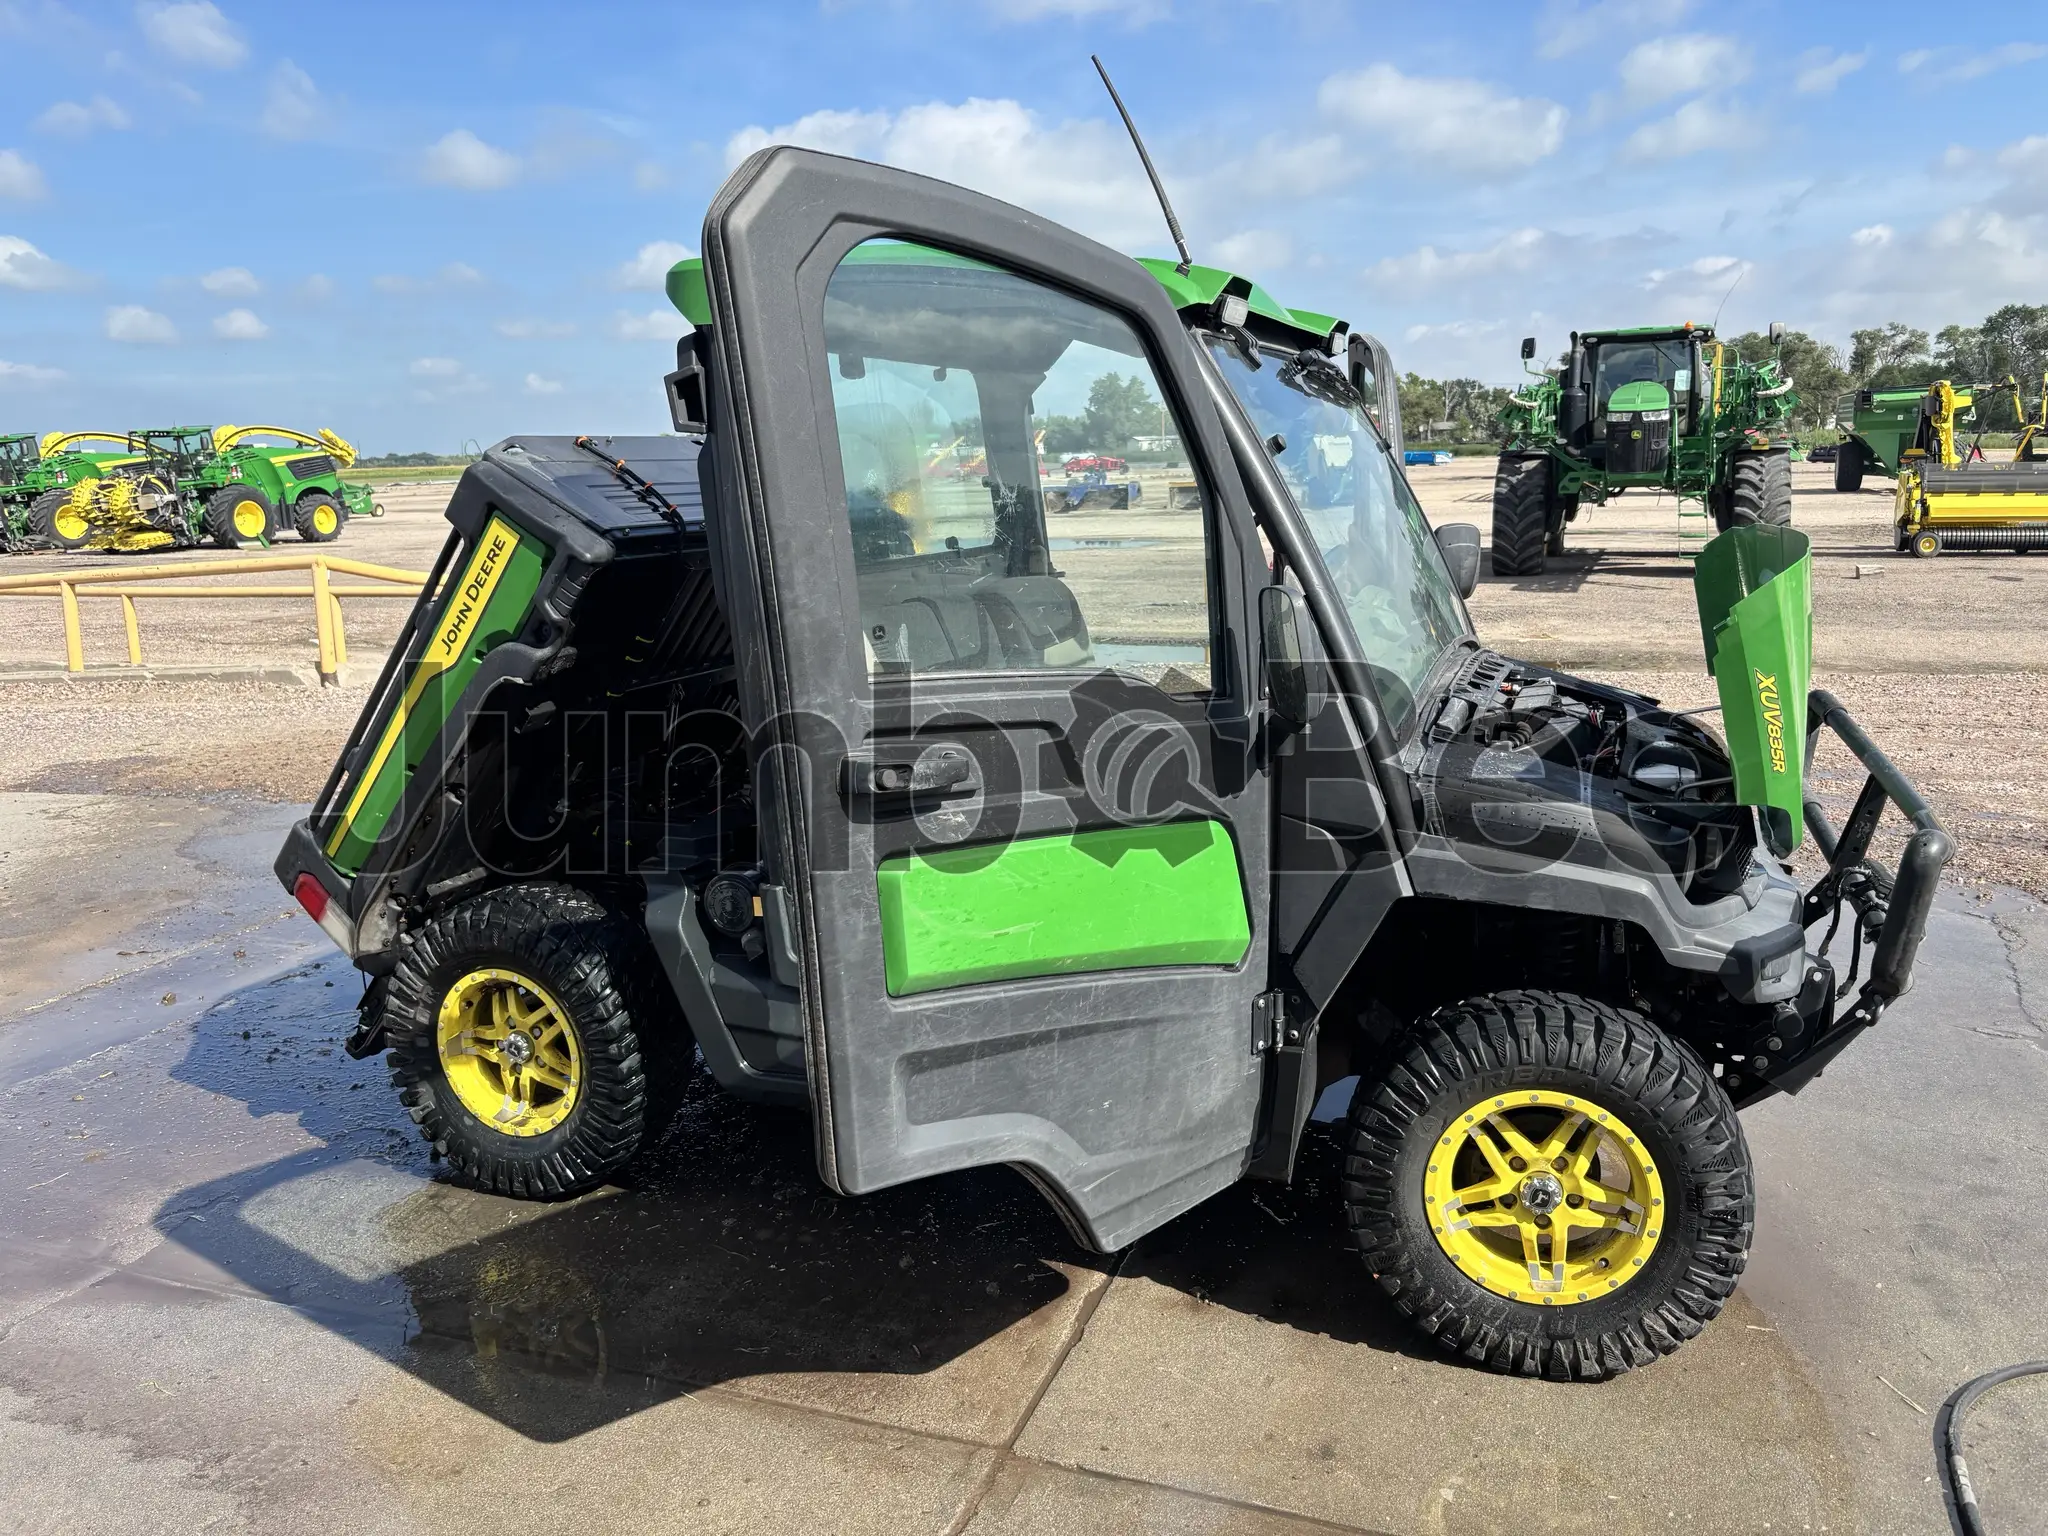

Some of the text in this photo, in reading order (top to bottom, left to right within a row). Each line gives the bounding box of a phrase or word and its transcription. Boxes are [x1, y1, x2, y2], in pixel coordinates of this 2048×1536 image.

[441, 534, 507, 656] JOHN DEERE
[1754, 668, 1786, 774] XUV835R
